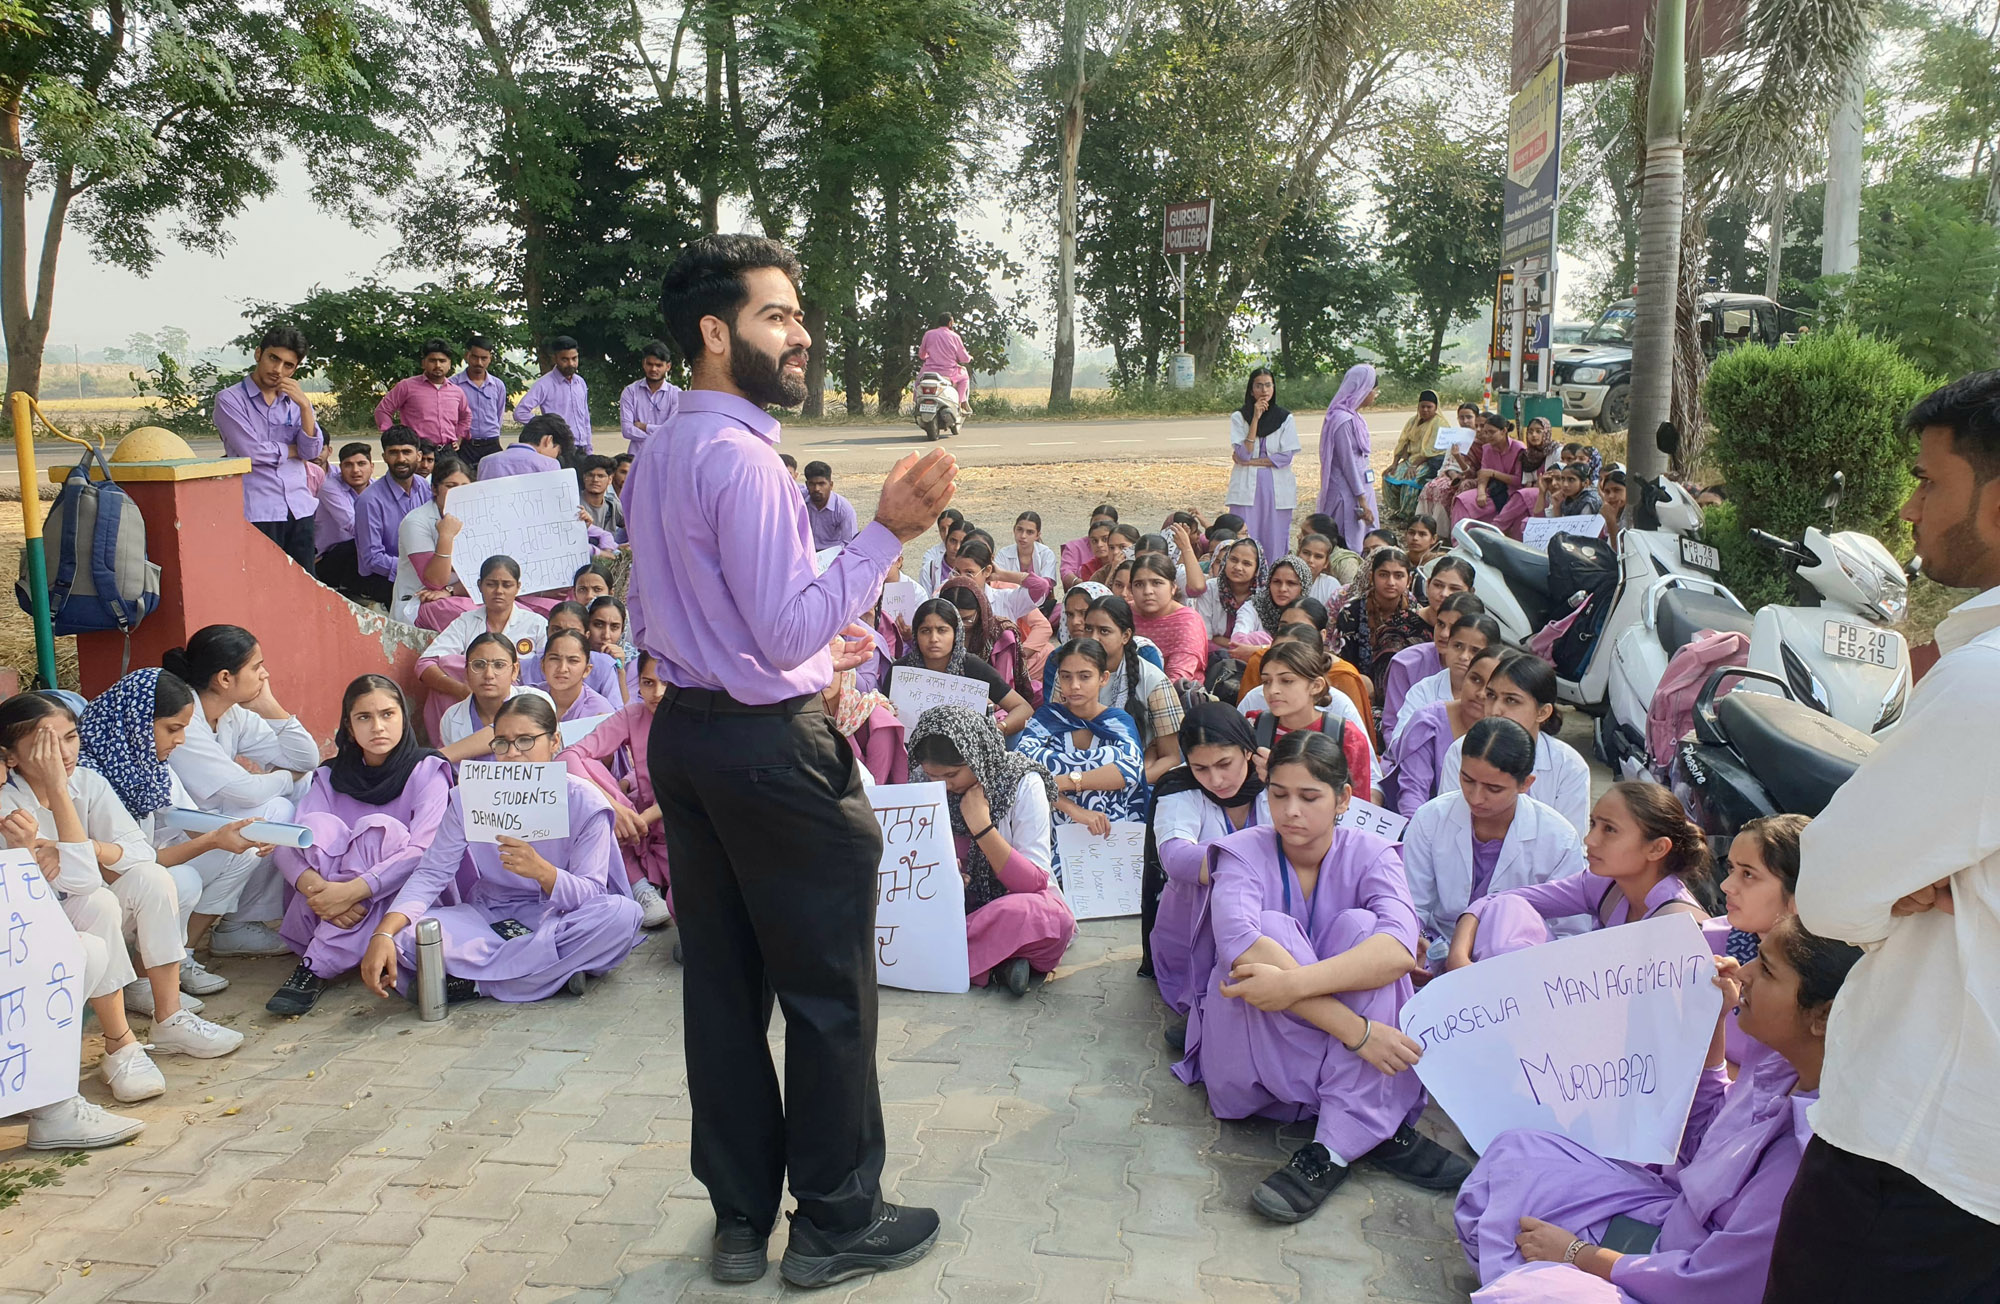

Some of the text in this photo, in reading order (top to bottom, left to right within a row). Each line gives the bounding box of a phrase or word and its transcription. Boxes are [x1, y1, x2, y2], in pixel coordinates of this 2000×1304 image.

[1170, 207, 1206, 227] GURSEWA
[1170, 228, 1201, 248] COLLEGE
[1609, 308, 1637, 317] POL
[1689, 541, 1698, 553] PB
[1839, 625, 1886, 649] PB 20
[1838, 641, 1885, 664] E5215
[465, 764, 545, 781] IMPLEMENT
[1680, 743, 1706, 785] Pleasure
[492, 787, 557, 806] STUDENTS
[471, 810, 522, 831] DEMANDS
[873, 803, 940, 844] ਾਲਜ
[1376, 817, 1392, 835] Ju
[532, 829, 550, 839] PSU
[1125, 831, 1143, 846] No
[1405, 955, 1705, 1051] GURSEWA MANAGEMENT
[1520, 1053, 1656, 1105] MURDABAD
